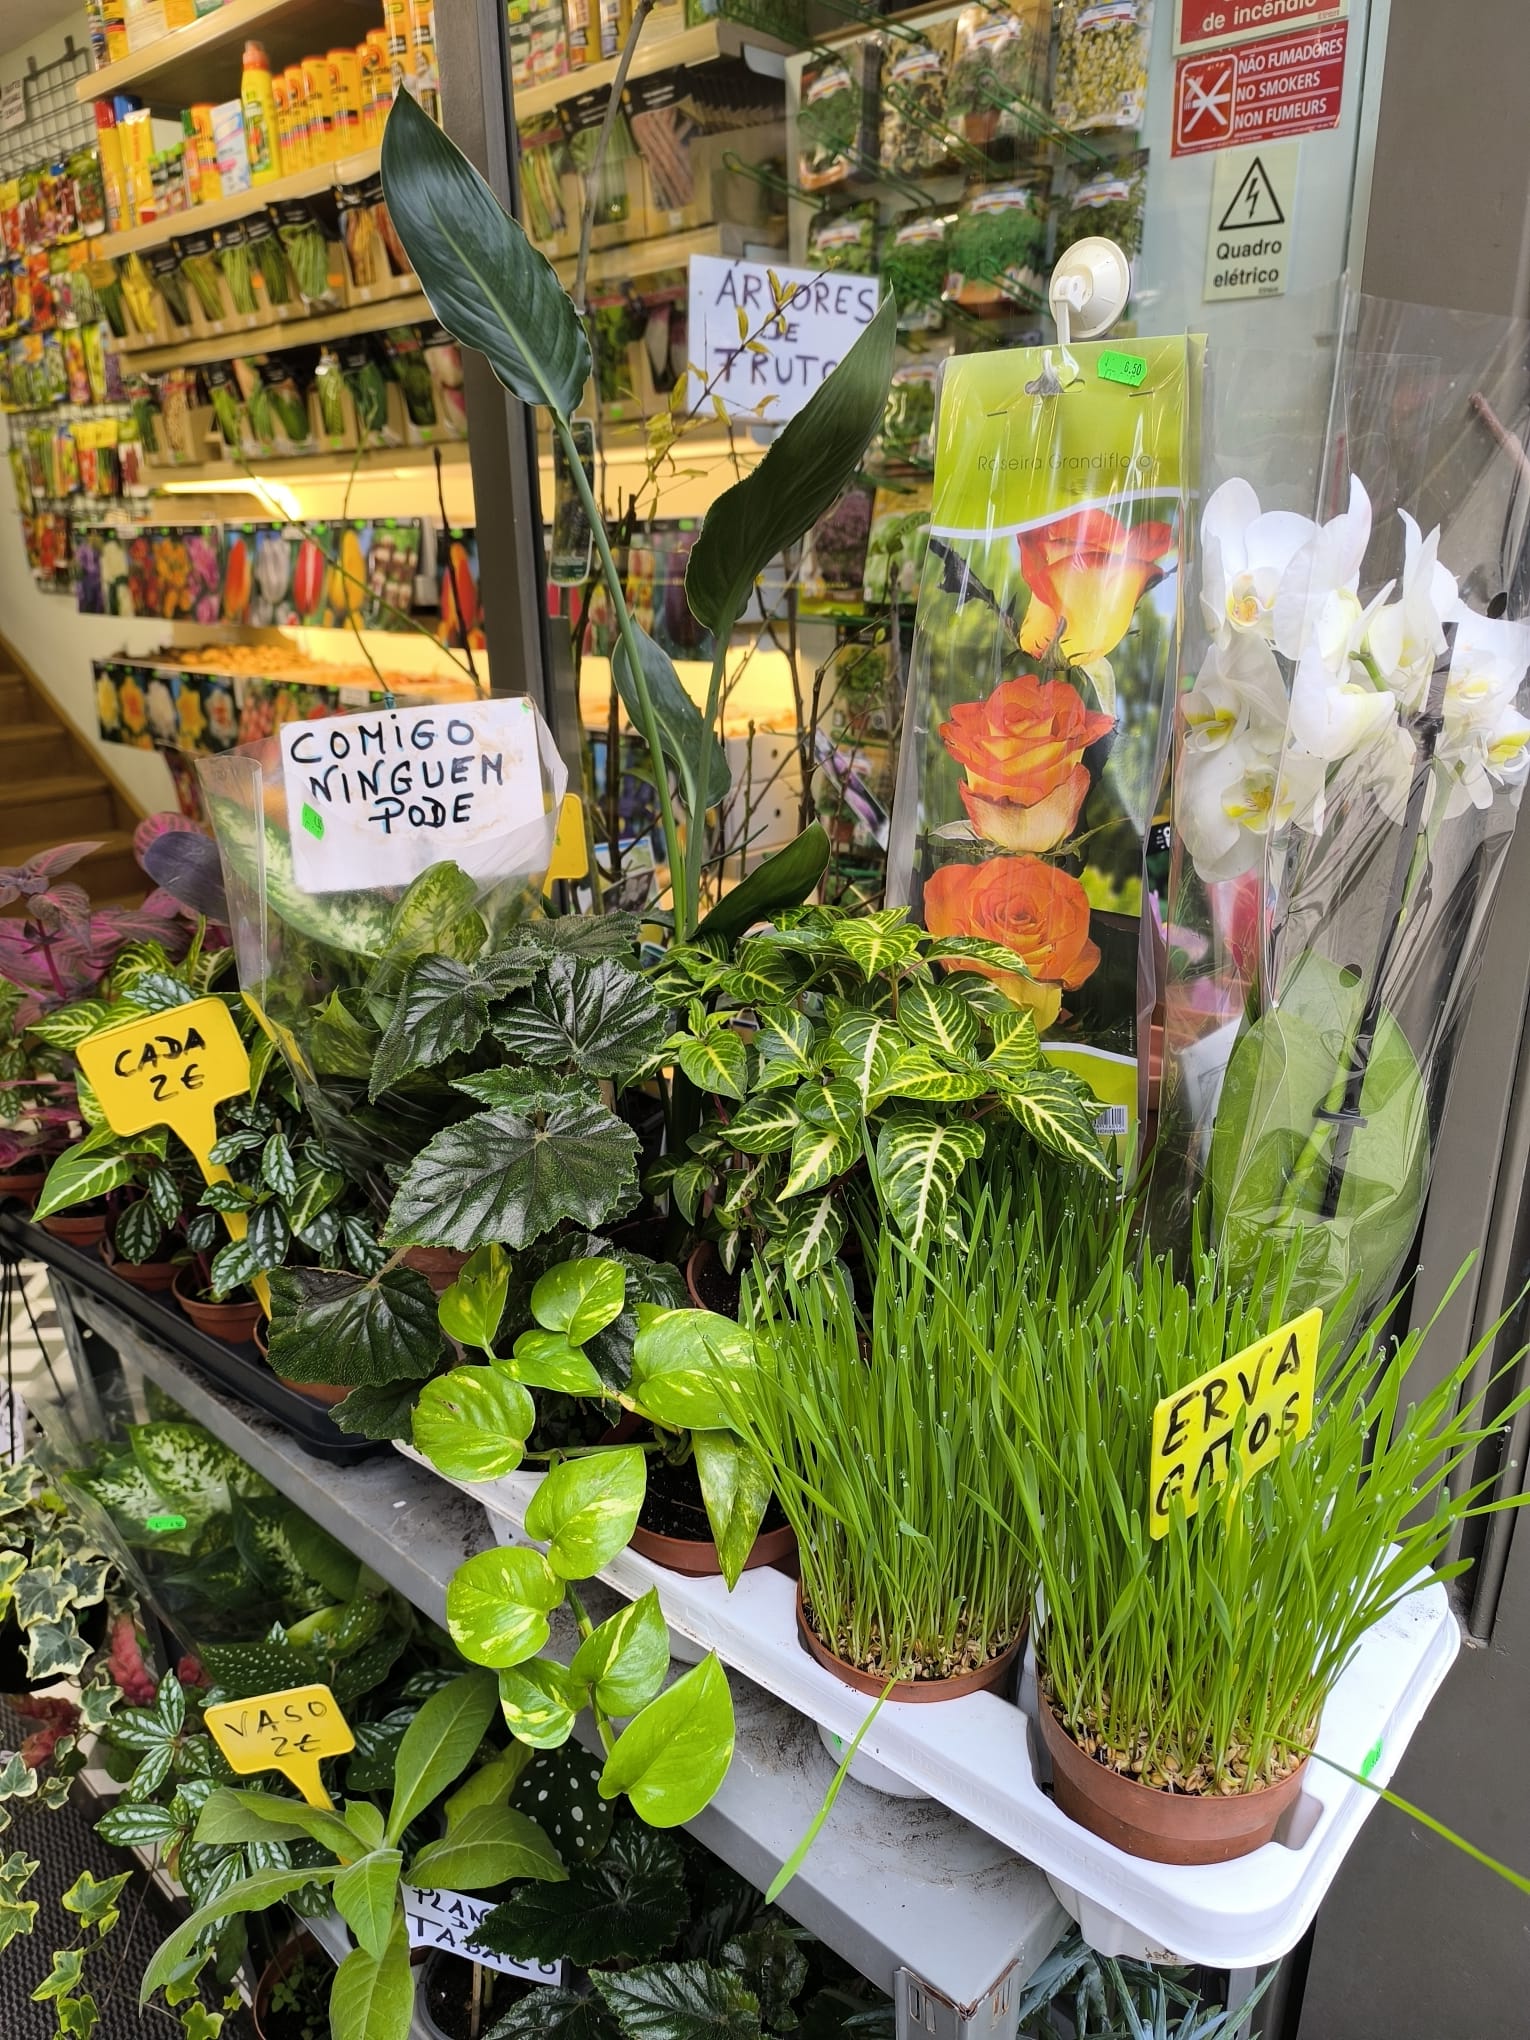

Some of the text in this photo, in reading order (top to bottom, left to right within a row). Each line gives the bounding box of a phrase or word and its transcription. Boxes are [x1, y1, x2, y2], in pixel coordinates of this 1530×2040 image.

[1202, 12, 1226, 32] de
[1238, 37, 1344, 75] NÃO FUMADORES
[1236, 71, 1321, 102] NO SMOKERS
[1235, 110, 1263, 129] NON
[1266, 97, 1327, 122] FUMEURS
[1216, 238, 1282, 260] Quadro
[716, 260, 875, 324] ÁRVORES
[1213, 267, 1279, 288] elétrico
[978, 455, 1042, 471] Roseira
[290, 714, 475, 763] COMIGO
[368, 792, 475, 834] PODE
[114, 1027, 206, 1077] CADA
[1161, 1332, 1301, 1456] ERVA
[224, 1701, 327, 1738] VASO
[412, 1888, 490, 1924] PLAN
